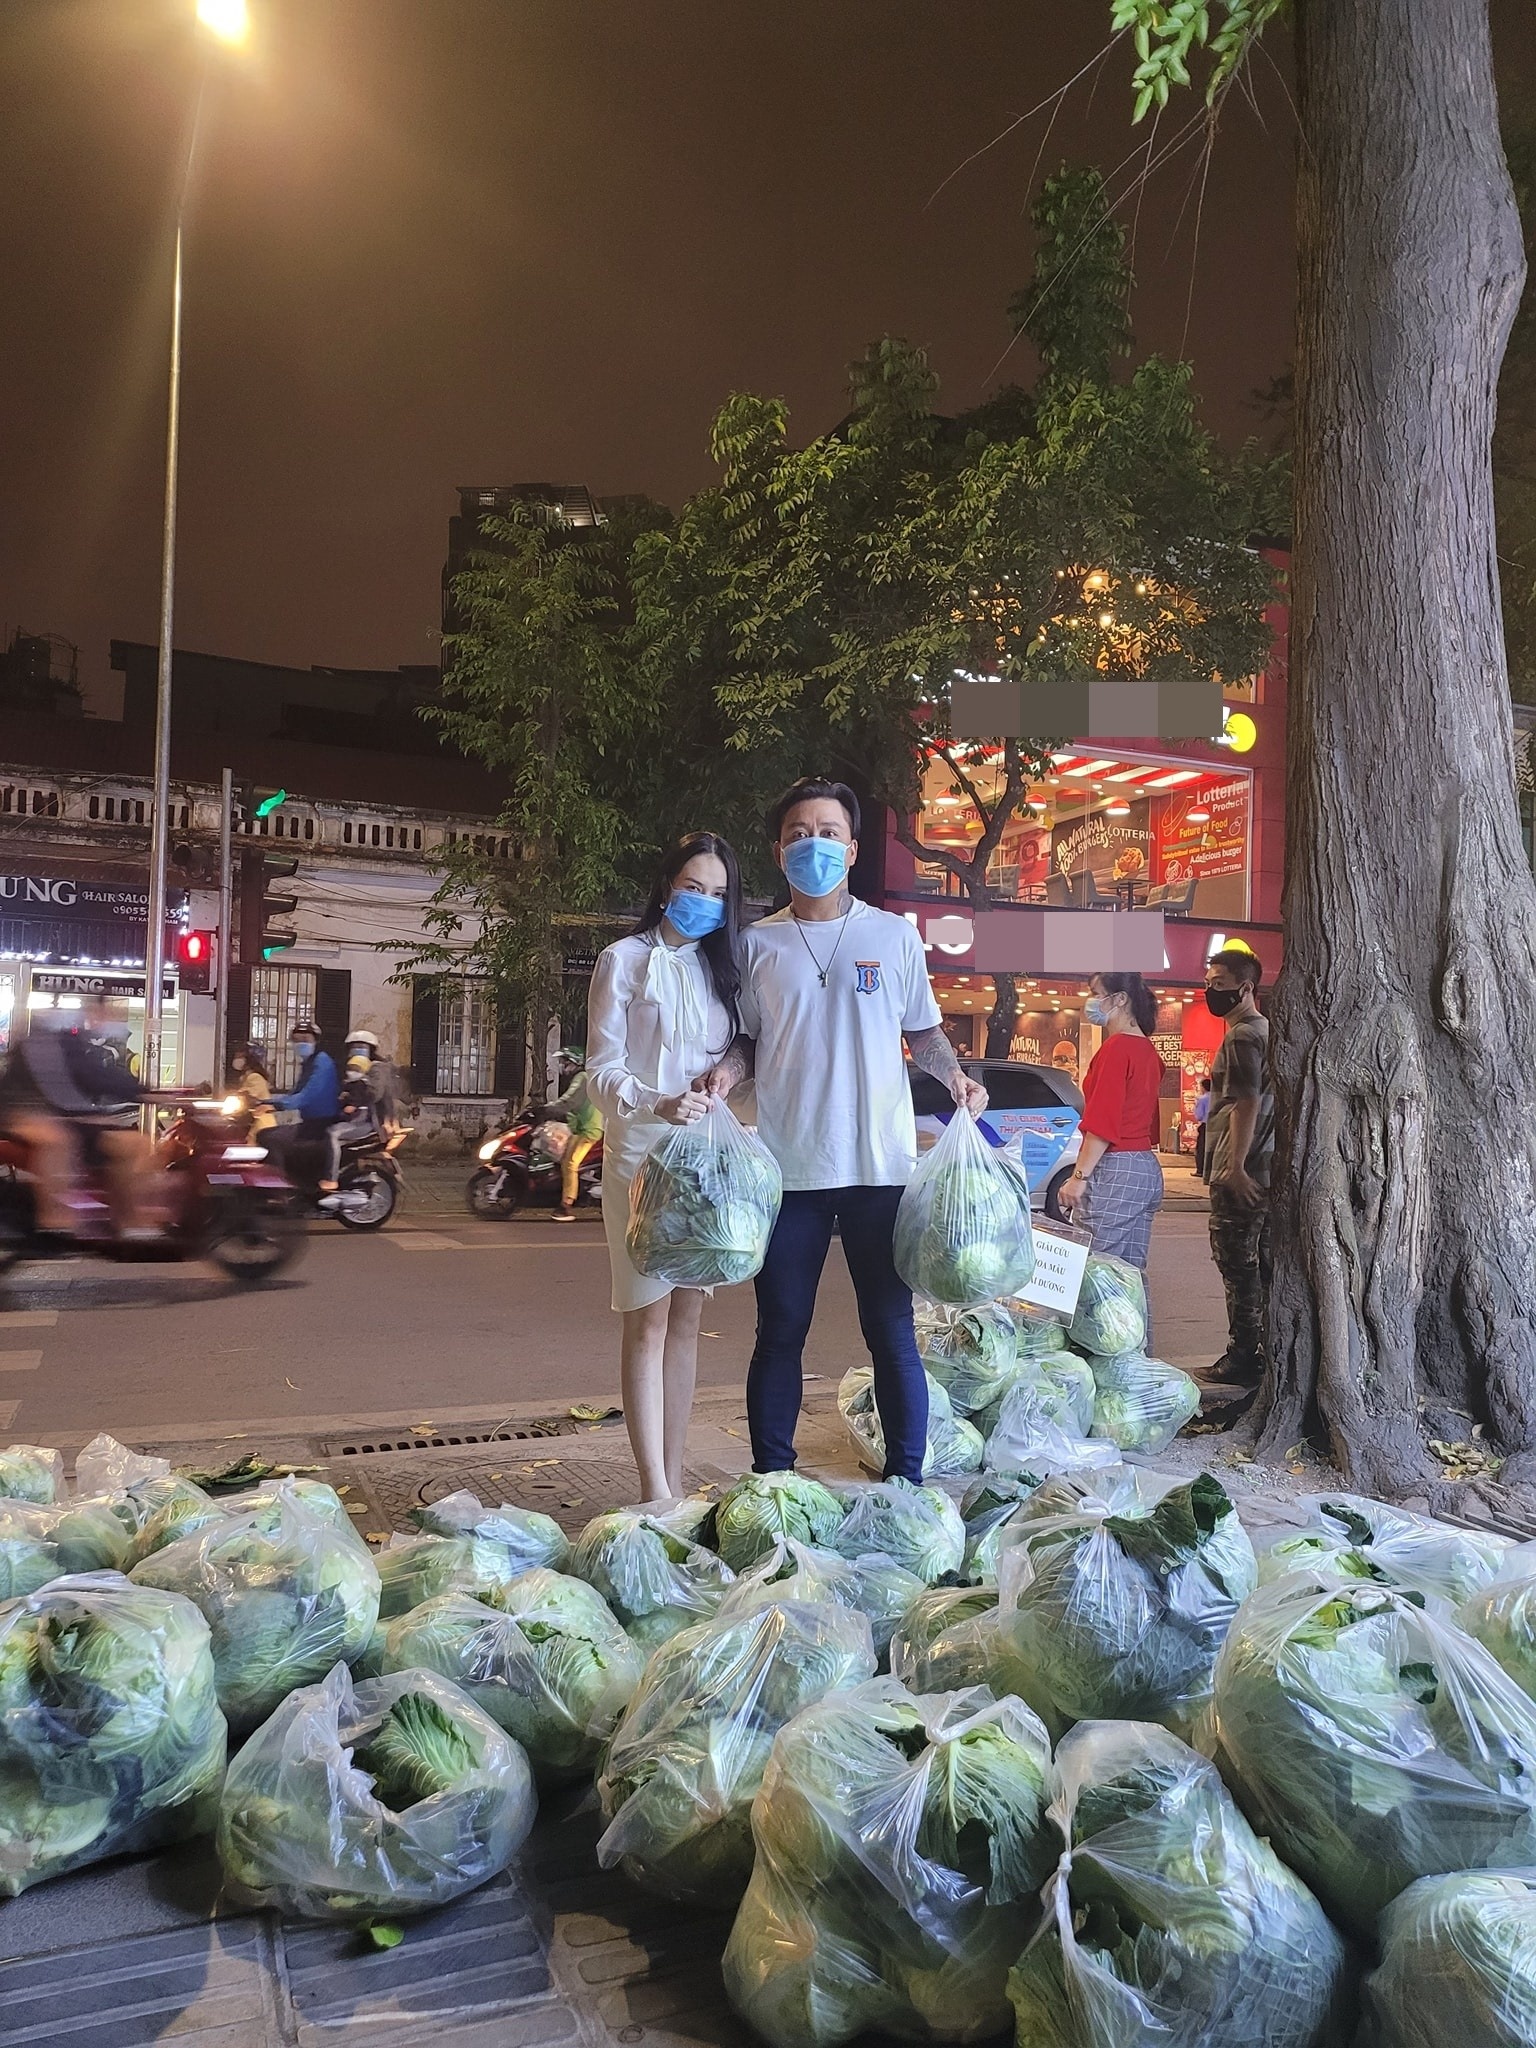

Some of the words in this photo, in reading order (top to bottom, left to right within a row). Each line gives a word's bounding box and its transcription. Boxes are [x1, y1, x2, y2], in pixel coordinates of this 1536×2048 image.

[1197, 781, 1245, 806] Lotteria
[1212, 798, 1243, 812] Product
[1179, 826, 1201, 839] Future
[1202, 821, 1210, 833] of
[1211, 817, 1228, 831] Food
[1222, 846, 1243, 858] burger
[82, 891, 116, 903] HAIR
[118, 892, 150, 905] SALO
[111, 986, 135, 996] HAIR
[1163, 1041, 1183, 1051] BEST
[1035, 1259, 1047, 1270] OA
